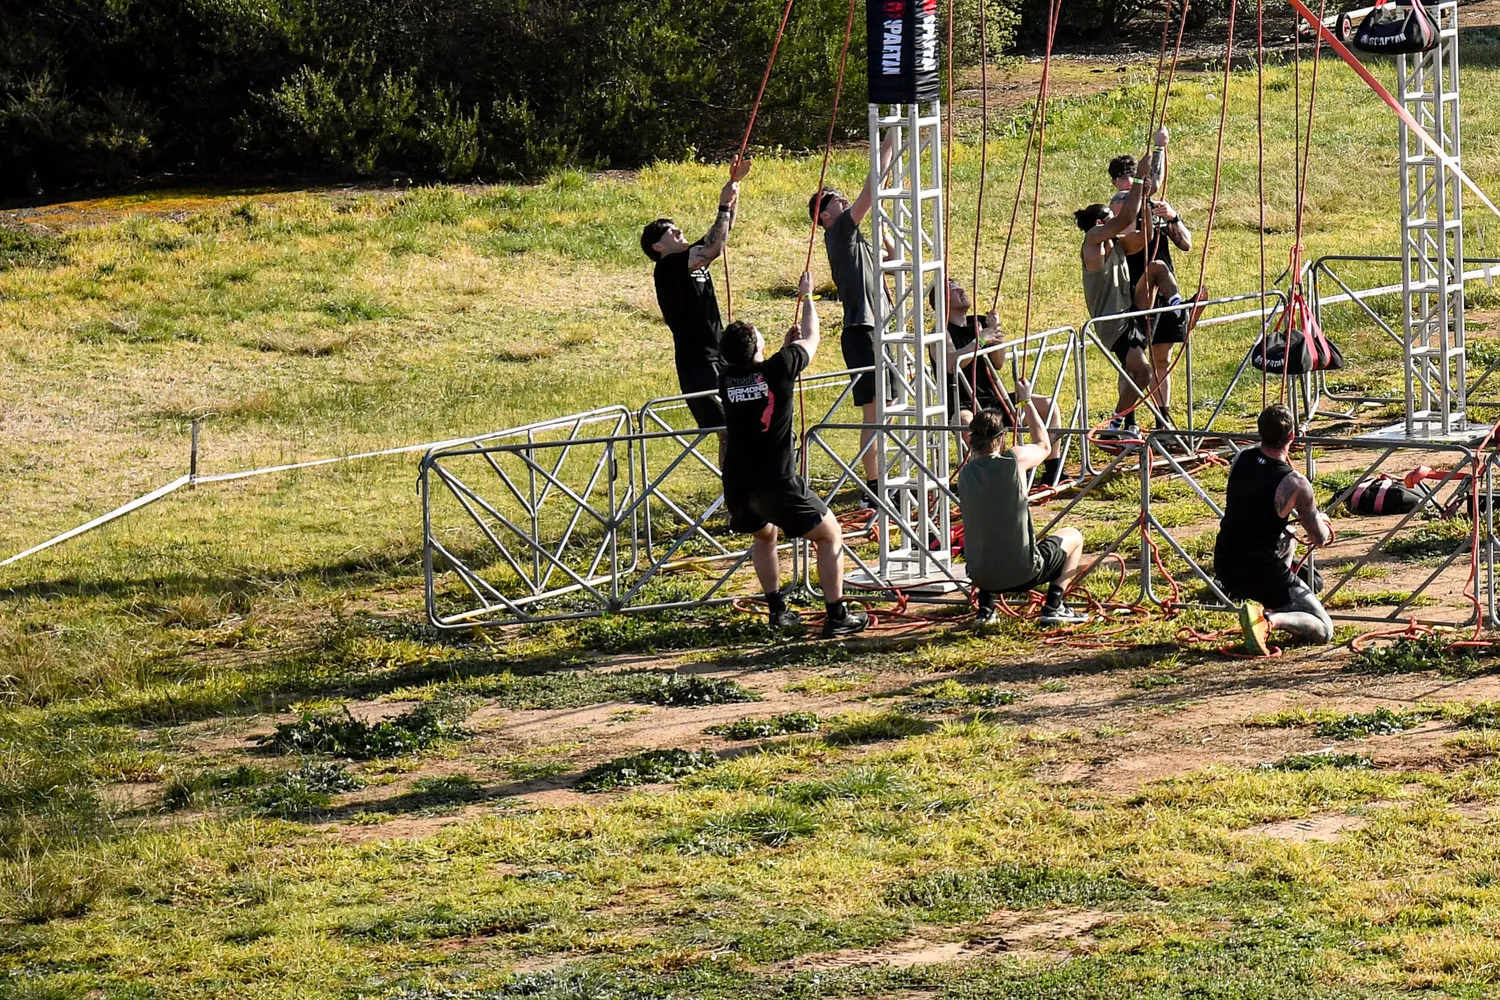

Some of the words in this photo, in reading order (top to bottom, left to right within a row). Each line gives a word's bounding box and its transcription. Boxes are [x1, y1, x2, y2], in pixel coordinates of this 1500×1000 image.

[1368, 33, 1406, 46] SPARTAN
[727, 382, 768, 395] DIAMOND
[728, 391, 769, 402] VALLEY
